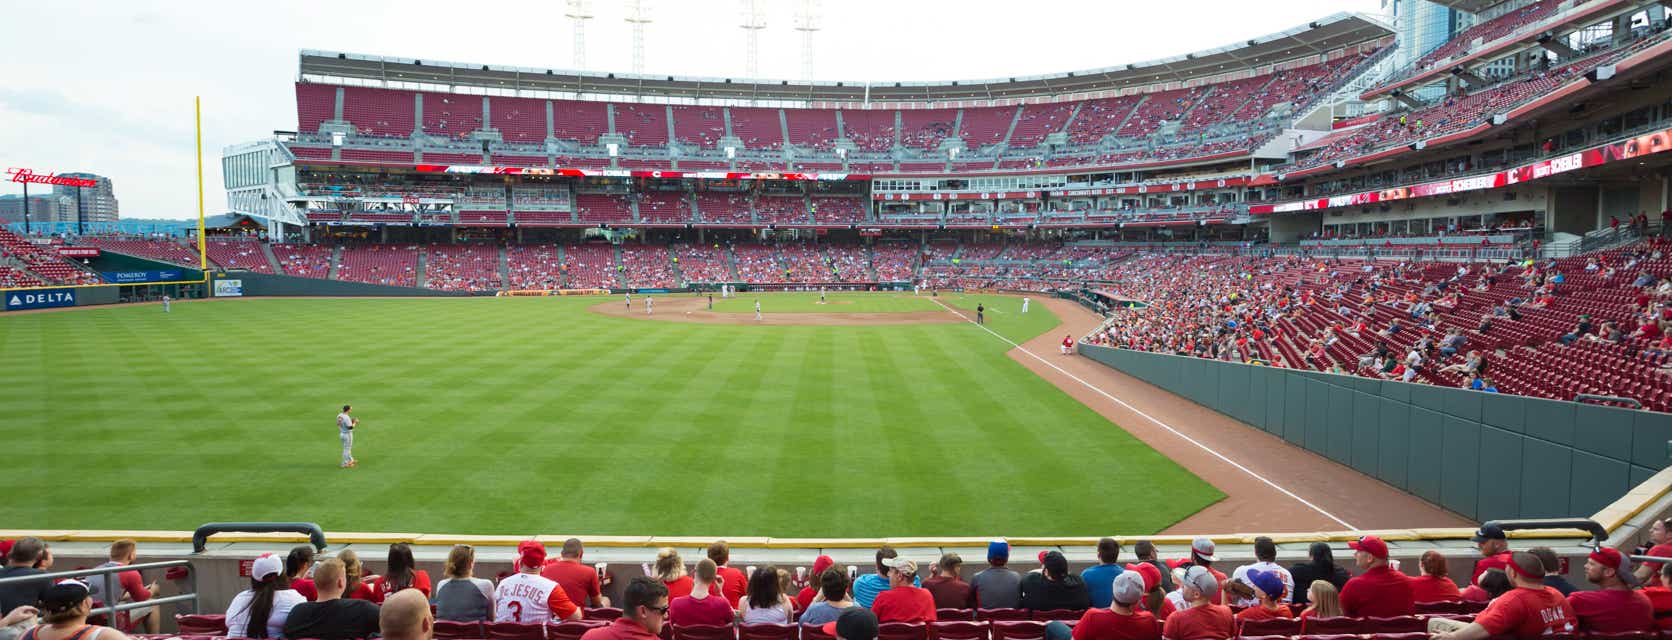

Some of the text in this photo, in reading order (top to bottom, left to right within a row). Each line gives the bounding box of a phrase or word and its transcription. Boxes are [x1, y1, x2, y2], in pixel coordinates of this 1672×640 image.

[25, 292, 73, 304] DELTA
[510, 583, 543, 602] JESUS
[508, 600, 523, 623] 3
